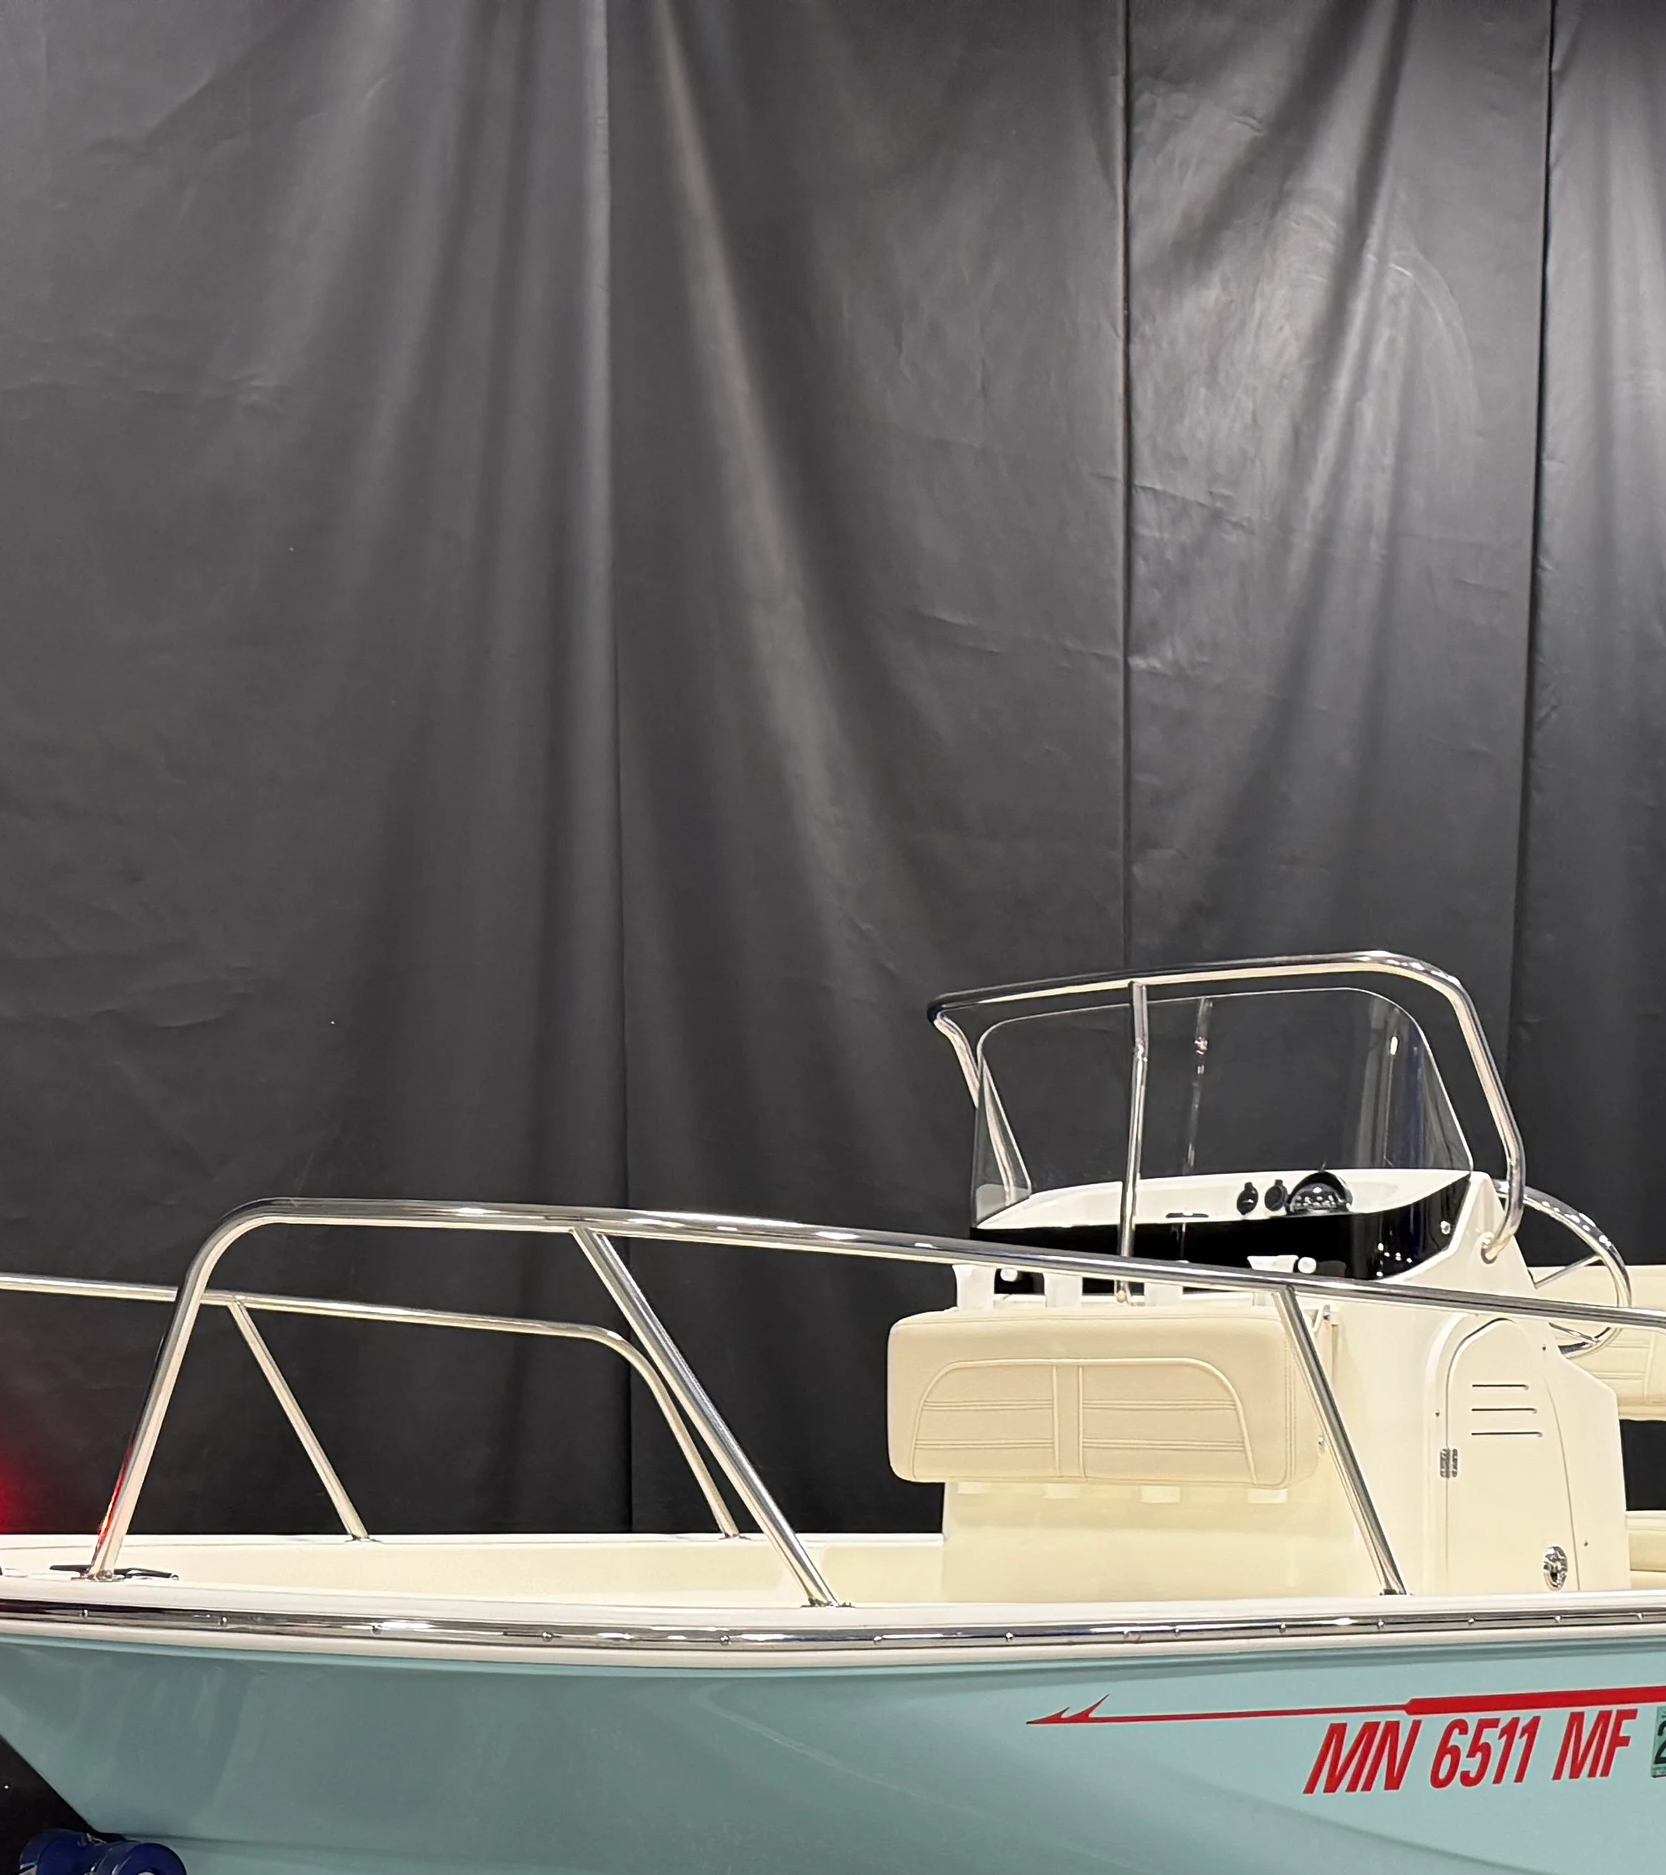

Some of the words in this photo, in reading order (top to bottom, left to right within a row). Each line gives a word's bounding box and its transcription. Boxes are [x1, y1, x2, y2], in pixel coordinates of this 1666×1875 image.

[1302, 1719, 1422, 1795] MN
[1430, 1715, 1541, 1789] 6511
[1552, 1708, 1638, 1780] MF
